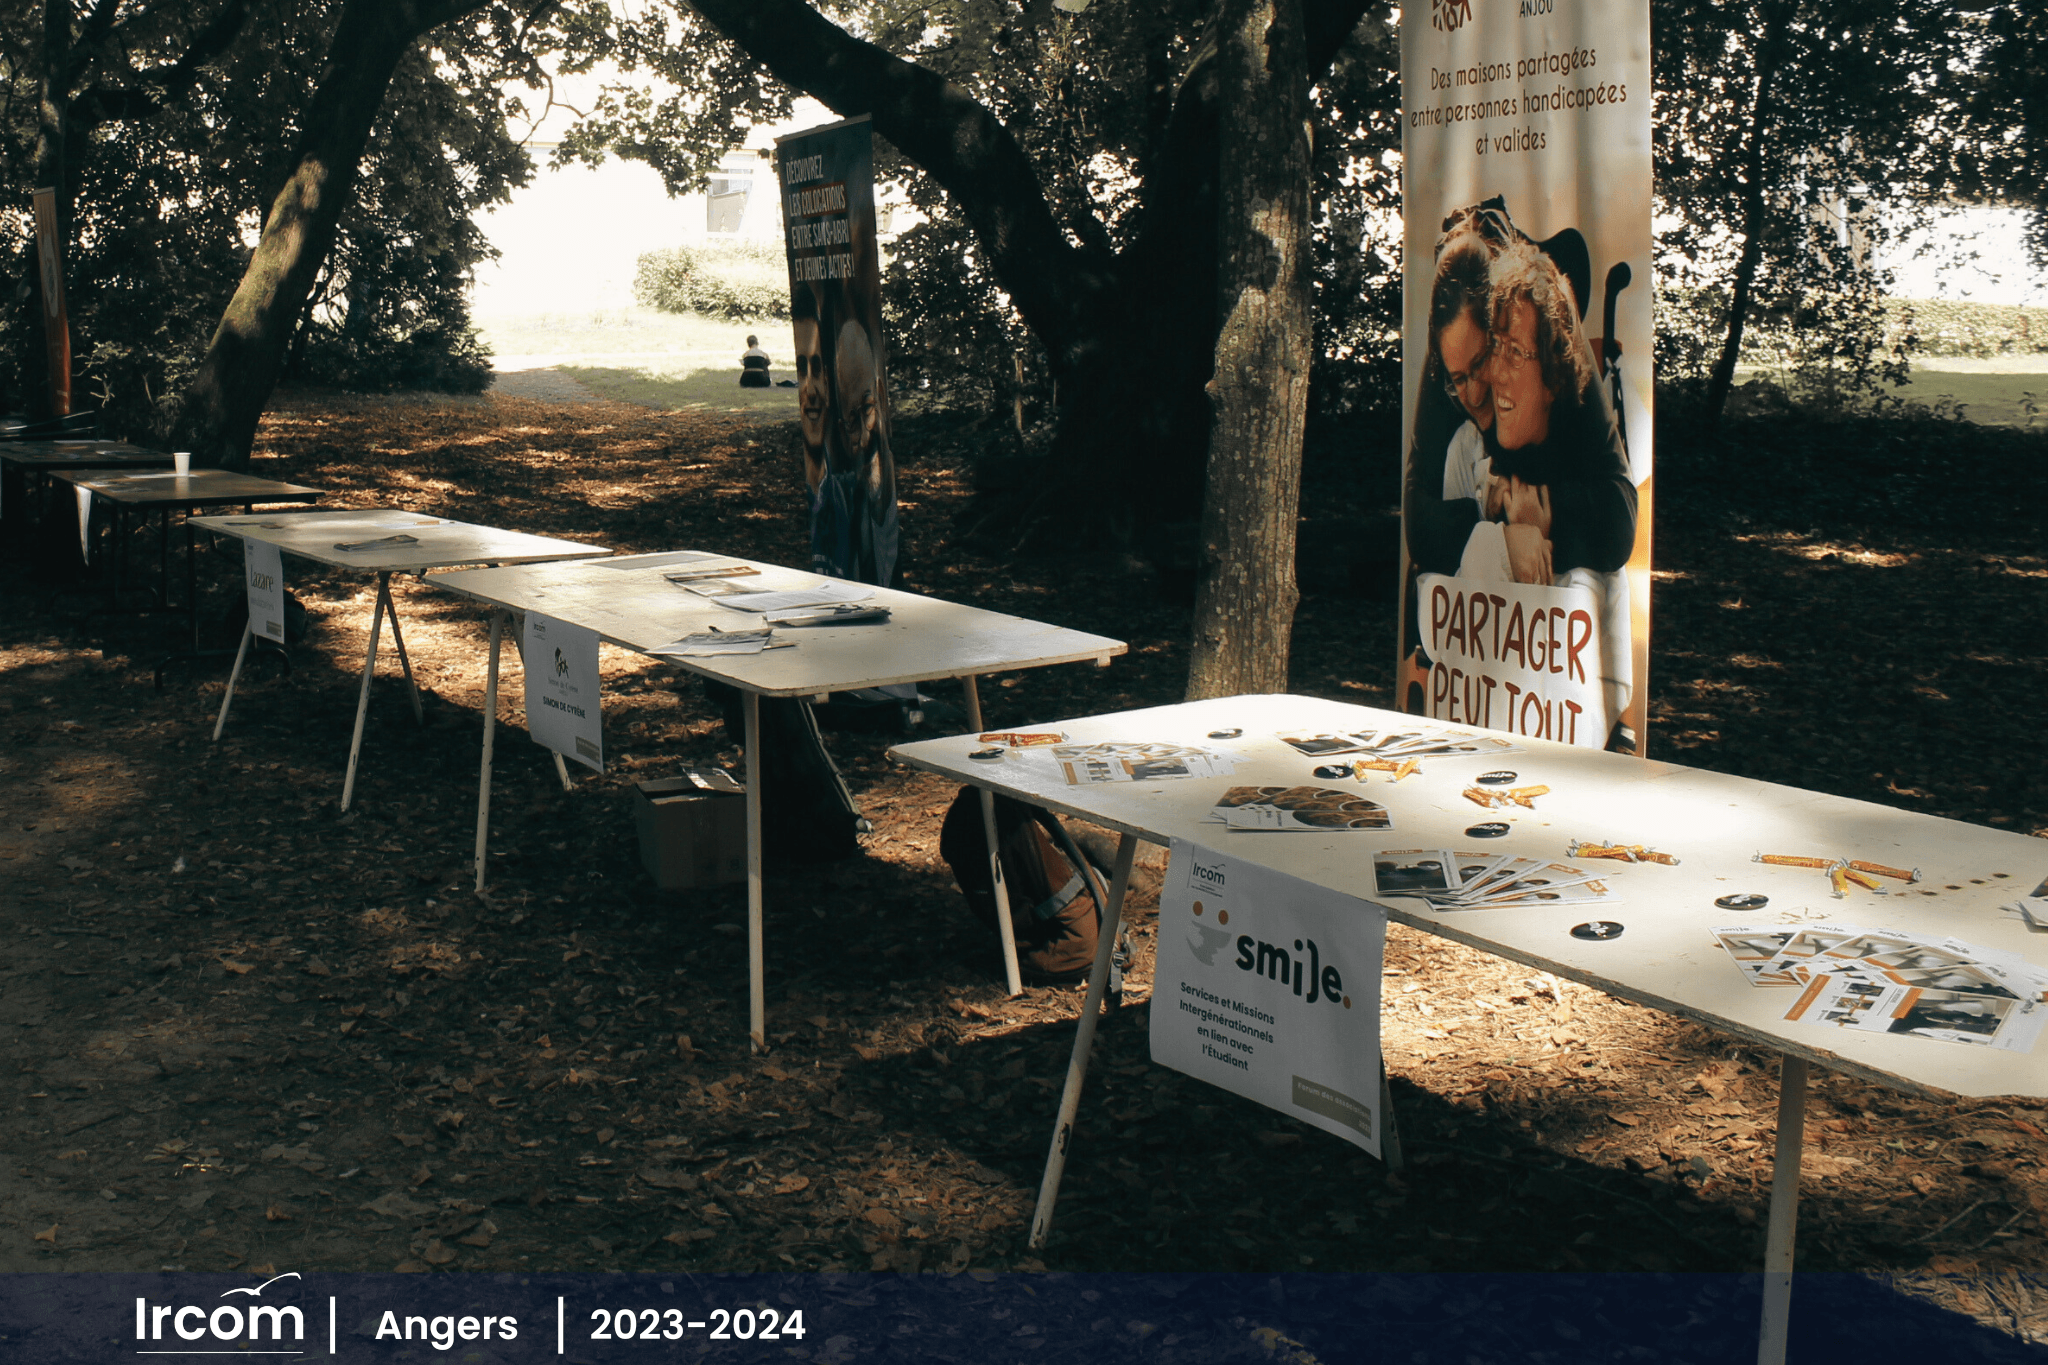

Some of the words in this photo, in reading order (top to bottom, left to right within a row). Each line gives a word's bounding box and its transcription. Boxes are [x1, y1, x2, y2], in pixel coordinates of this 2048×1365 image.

[1519, 0, 1553, 18] ANJOU
[1431, 67, 1451, 90] Des
[1456, 61, 1511, 87] maisons
[1517, 46, 1596, 82] partagées
[1411, 105, 1442, 128] entre
[1445, 97, 1517, 128] personnes
[1523, 81, 1627, 114] handicapées
[1476, 133, 1489, 155] et
[1493, 126, 1546, 153] valides
[786, 154, 823, 185] DÉCOUVREZ
[789, 192, 801, 217] LES
[801, 184, 846, 215] COLOCATIONS
[792, 223, 813, 250] ENTRE
[813, 218, 850, 247] SANS-ABRI
[795, 258, 804, 282] ET
[1431, 585, 1592, 684] PARTAGER
[543, 696, 559, 709] SIMON
[560, 702, 567, 712] DE
[1433, 662, 1497, 729] PEUT
[1193, 862, 1226, 885] Ircom
[1181, 981, 1219, 1005] Services
[1221, 998, 1231, 1009] et
[1232, 1001, 1275, 1025] Missions
[1180, 999, 1274, 1044] Intergénérationnels
[1197, 1026, 1209, 1038] en
[1211, 1029, 1228, 1045] lien
[1230, 1038, 1254, 1055] avec
